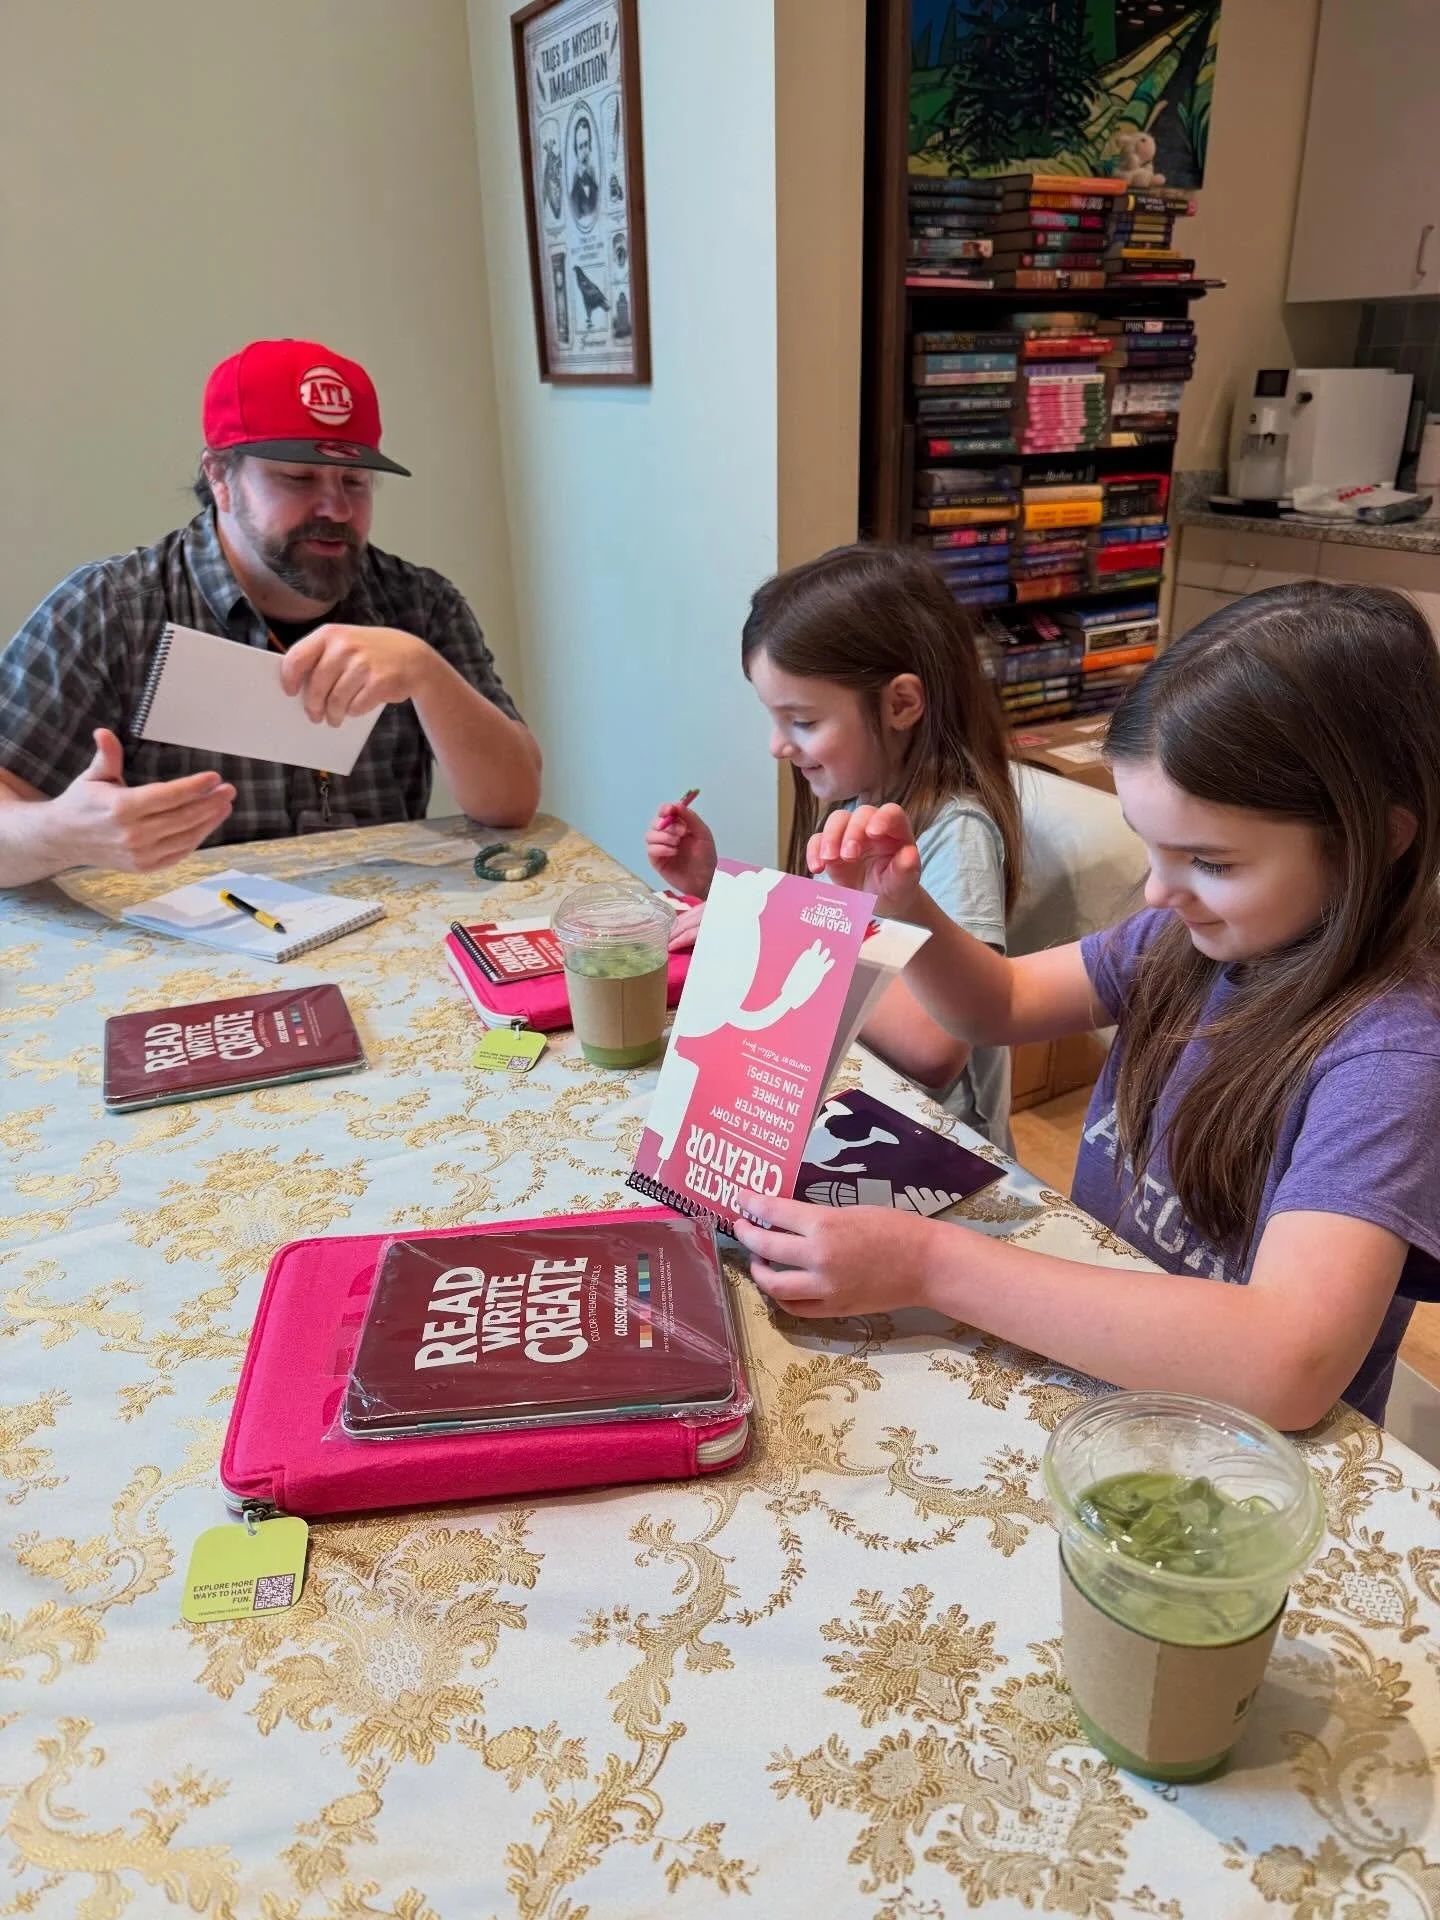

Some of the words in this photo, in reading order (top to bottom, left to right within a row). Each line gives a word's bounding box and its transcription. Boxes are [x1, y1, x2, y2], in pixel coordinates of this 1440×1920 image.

[541, 44, 560, 74] TALES
[562, 38, 570, 64] OF
[571, 21, 602, 58] MYSTERY
[549, 51, 608, 104] IMAGINATION
[309, 382, 350, 408] ATL
[800, 908, 826, 928] WRITE
[815, 903, 844, 919] CREATE
[503, 935, 550, 970] CREATOR
[144, 1022, 190, 1074] READ
[184, 1021, 217, 1061] WRITE
[213, 1009, 265, 1061] CREATE
[746, 1064, 782, 1089] STEPS!
[782, 1079, 804, 1099] FUN
[751, 1085, 784, 1111] THREE
[786, 1101, 800, 1117] IN
[709, 1104, 742, 1128] STORY
[734, 1097, 795, 1133] CHARACTER
[742, 1118, 750, 1132] A
[750, 1125, 790, 1151] CREATE
[685, 1124, 783, 1197] CREATOR
[589, 1264, 602, 1290] PENCILS
[613, 1264, 628, 1284] BOOK
[613, 1284, 628, 1307] COMIC
[414, 1266, 486, 1370] READ
[481, 1272, 527, 1354] WRITE
[524, 1256, 589, 1364] CREATE
[587, 1290, 601, 1342] COLOR-THEMED
[614, 1306, 629, 1337] CLASSIC
[193, 1582, 230, 1593] EXPLORE
[231, 1579, 255, 1589] MORE
[193, 1591, 217, 1601] WAYS
[219, 1590, 230, 1598] TO
[230, 1587, 253, 1596] HAVE
[232, 1595, 252, 1604] FUN.
